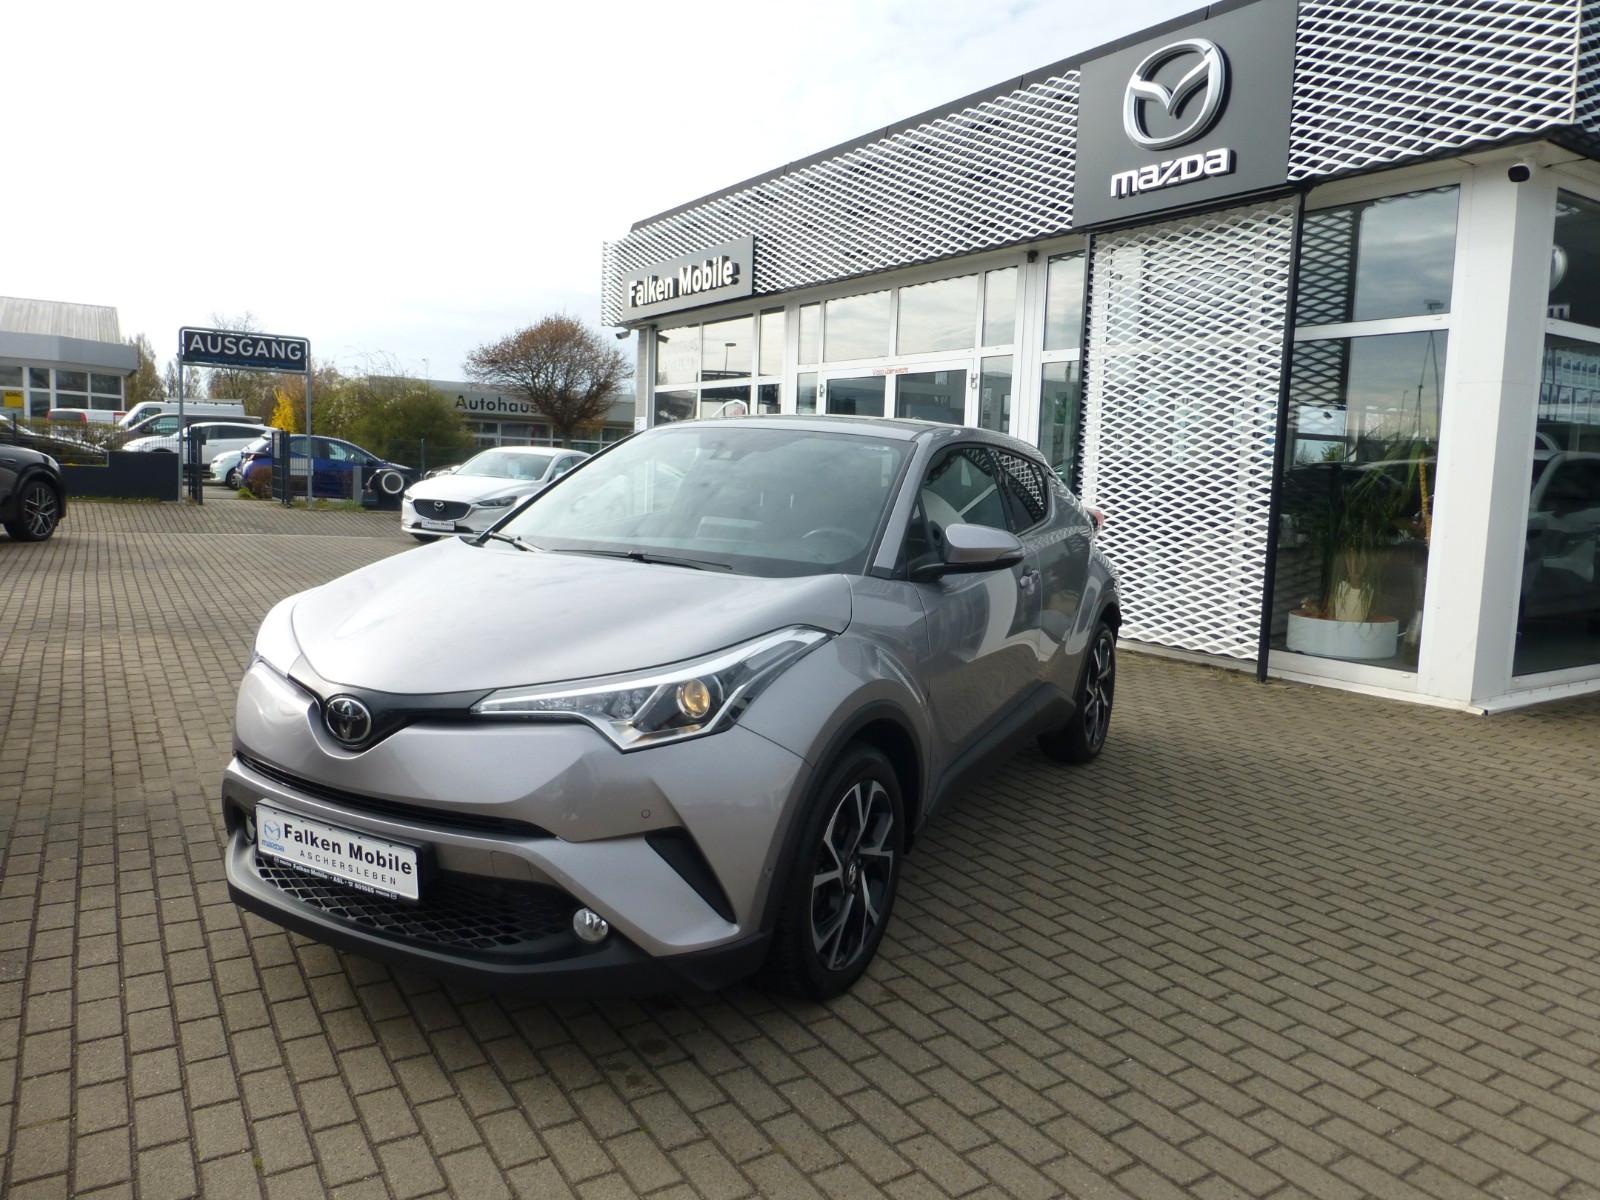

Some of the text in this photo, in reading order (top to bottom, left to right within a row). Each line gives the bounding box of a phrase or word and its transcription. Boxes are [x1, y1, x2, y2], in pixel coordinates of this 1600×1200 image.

[628, 255, 738, 307] Falken Mobile
[189, 334, 302, 360] AUSGANG
[455, 395, 538, 413] Autohaus
[284, 823, 412, 875] Falken Mobile
[300, 850, 396, 885] ASCHERSLEBEN
